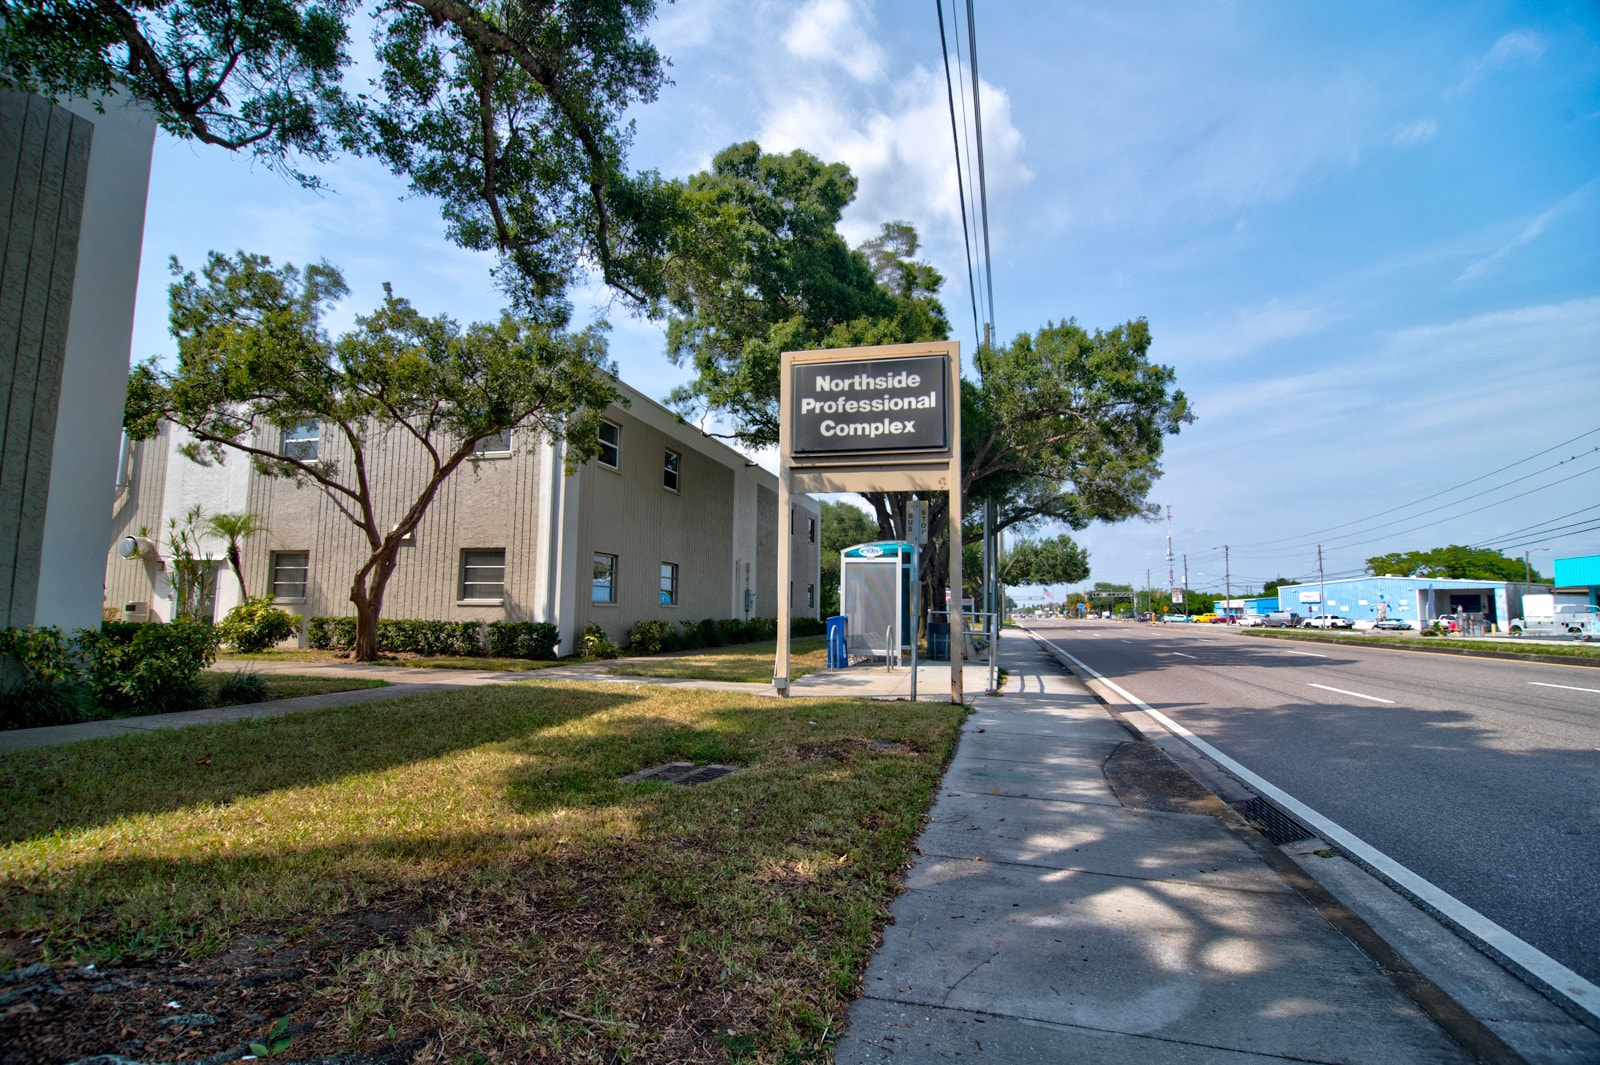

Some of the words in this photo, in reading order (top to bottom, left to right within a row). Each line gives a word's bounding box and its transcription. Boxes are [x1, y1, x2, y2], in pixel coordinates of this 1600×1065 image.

[815, 371, 921, 392] Northside
[802, 392, 936, 414] Professional
[820, 418, 916, 438] Complex
